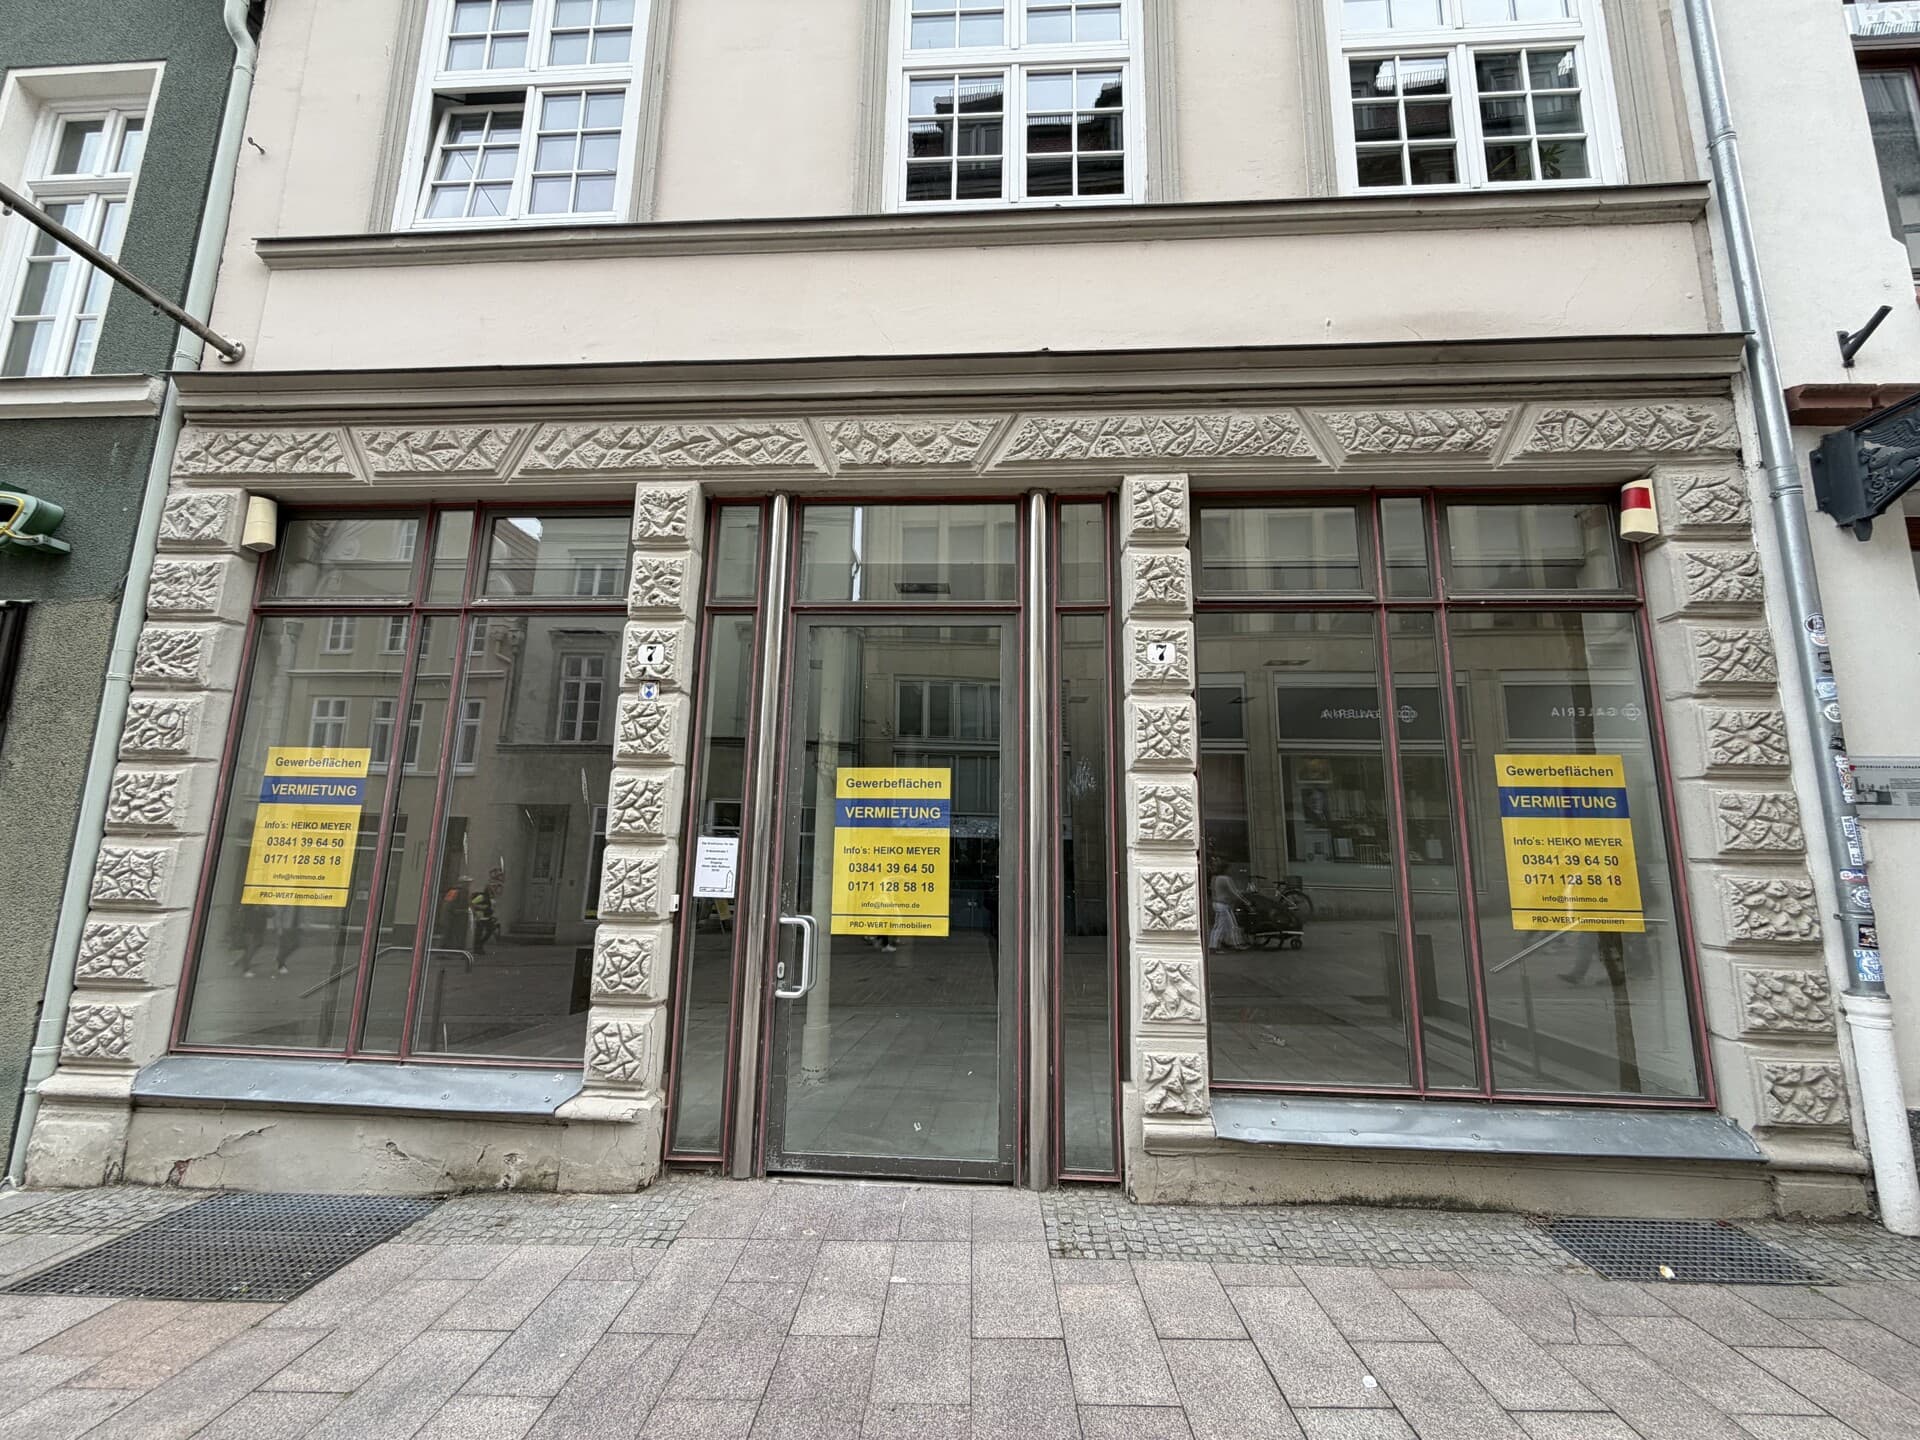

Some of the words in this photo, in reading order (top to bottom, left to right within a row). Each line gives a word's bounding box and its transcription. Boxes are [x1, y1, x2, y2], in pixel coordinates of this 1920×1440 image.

[646, 646, 656, 662] 7
[1156, 644, 1166, 661] 7
[276, 757, 362, 768] Gewerbeflächen
[1506, 765, 1614, 777] Gewerbeflächen
[846, 778, 942, 789] Gewerbeflächen
[272, 784, 357, 796] VERMIETUNG
[1508, 795, 1617, 808] VERMIETUNG
[845, 806, 941, 819] VERMIETUNG
[266, 837, 297, 846] 03841
[300, 838, 313, 847] 39
[316, 838, 328, 847] 64
[332, 838, 344, 847] 50
[1547, 837, 1582, 846] HEIKO
[1584, 838, 1623, 847] MEYER
[873, 846, 903, 855] HEIKO
[906, 846, 940, 855] MEYER
[264, 854, 288, 864] 0171
[292, 854, 310, 864] 128
[313, 855, 325, 865] 58
[330, 856, 341, 865] 18
[1522, 855, 1560, 865] 03841
[1565, 855, 1580, 865] 39
[1584, 855, 1600, 866] 64
[1604, 856, 1618, 866] 50
[848, 863, 882, 873] 03841
[886, 863, 900, 874] 39
[903, 864, 917, 874] 64
[921, 864, 935, 874] 50
[1524, 874, 1555, 884] 0171
[1560, 874, 1583, 885] 128
[1587, 875, 1602, 885] 58
[1606, 875, 1622, 885] 18
[848, 881, 874, 892] 0171
[880, 882, 899, 892] 128
[903, 882, 917, 892] 58
[921, 882, 934, 892] 18
[1532, 916, 1575, 924] PRO-WERT
